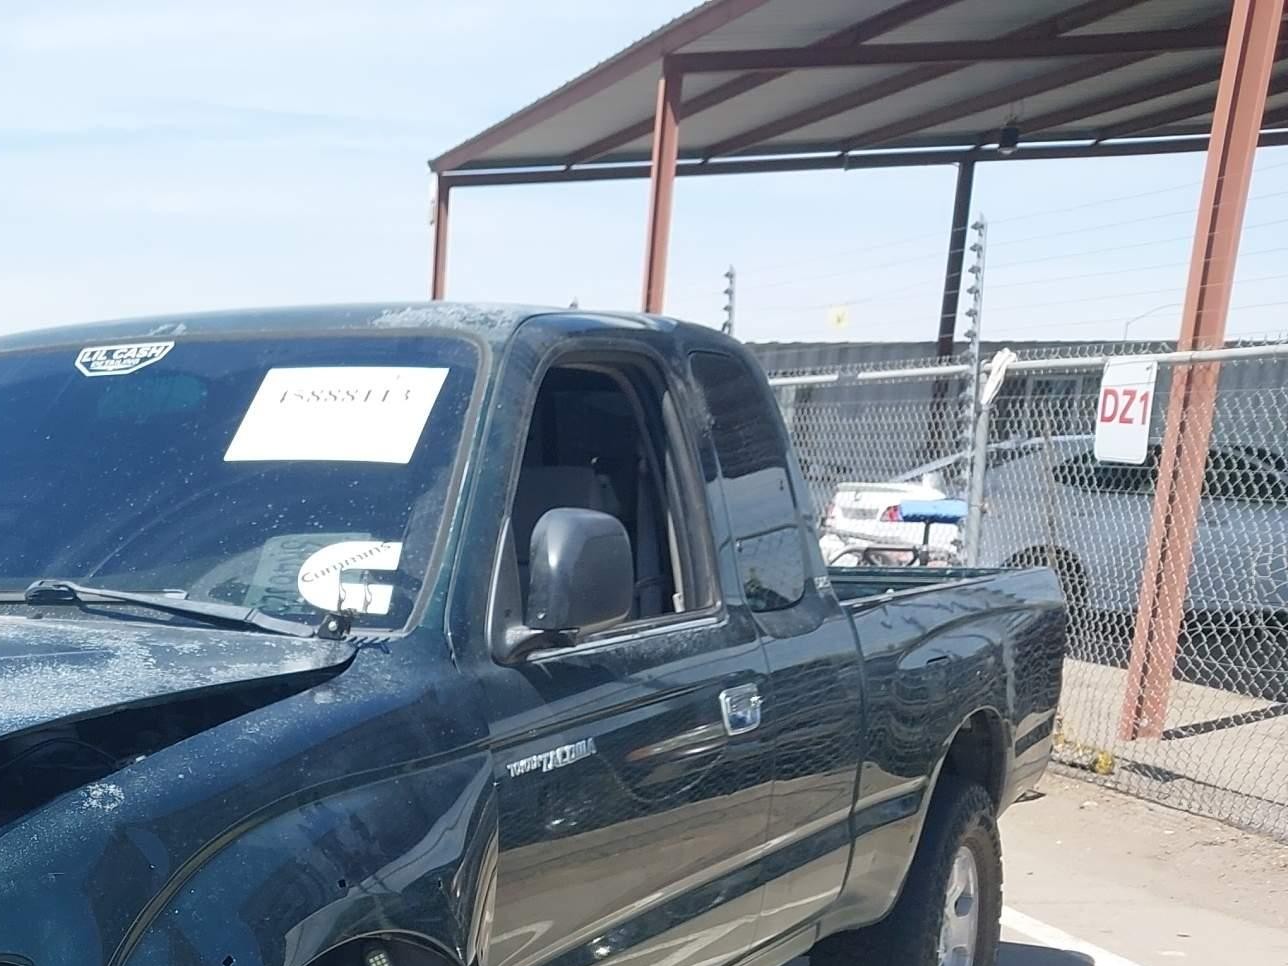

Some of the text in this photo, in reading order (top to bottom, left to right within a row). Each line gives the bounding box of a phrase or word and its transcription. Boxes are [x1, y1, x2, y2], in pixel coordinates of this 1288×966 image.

[80, 345, 166, 362] LIL CASH
[1100, 388, 1150, 426] DZ1
